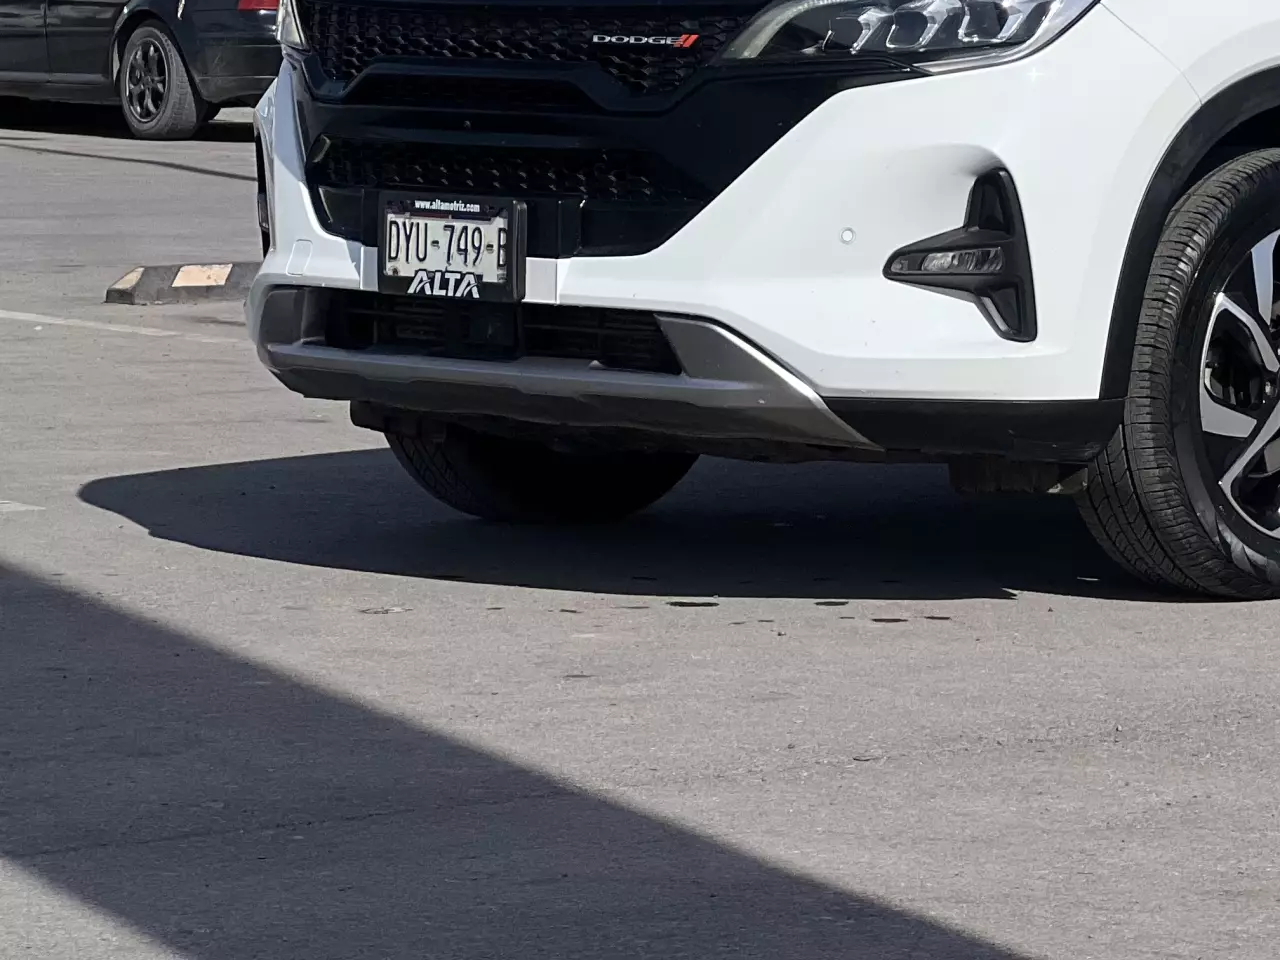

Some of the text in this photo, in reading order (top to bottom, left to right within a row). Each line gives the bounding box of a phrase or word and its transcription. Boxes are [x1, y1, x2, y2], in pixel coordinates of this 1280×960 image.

[592, 34, 684, 45] DODGE
[414, 198, 480, 213] www.altamotriz.com
[407, 268, 480, 299] ALTA
